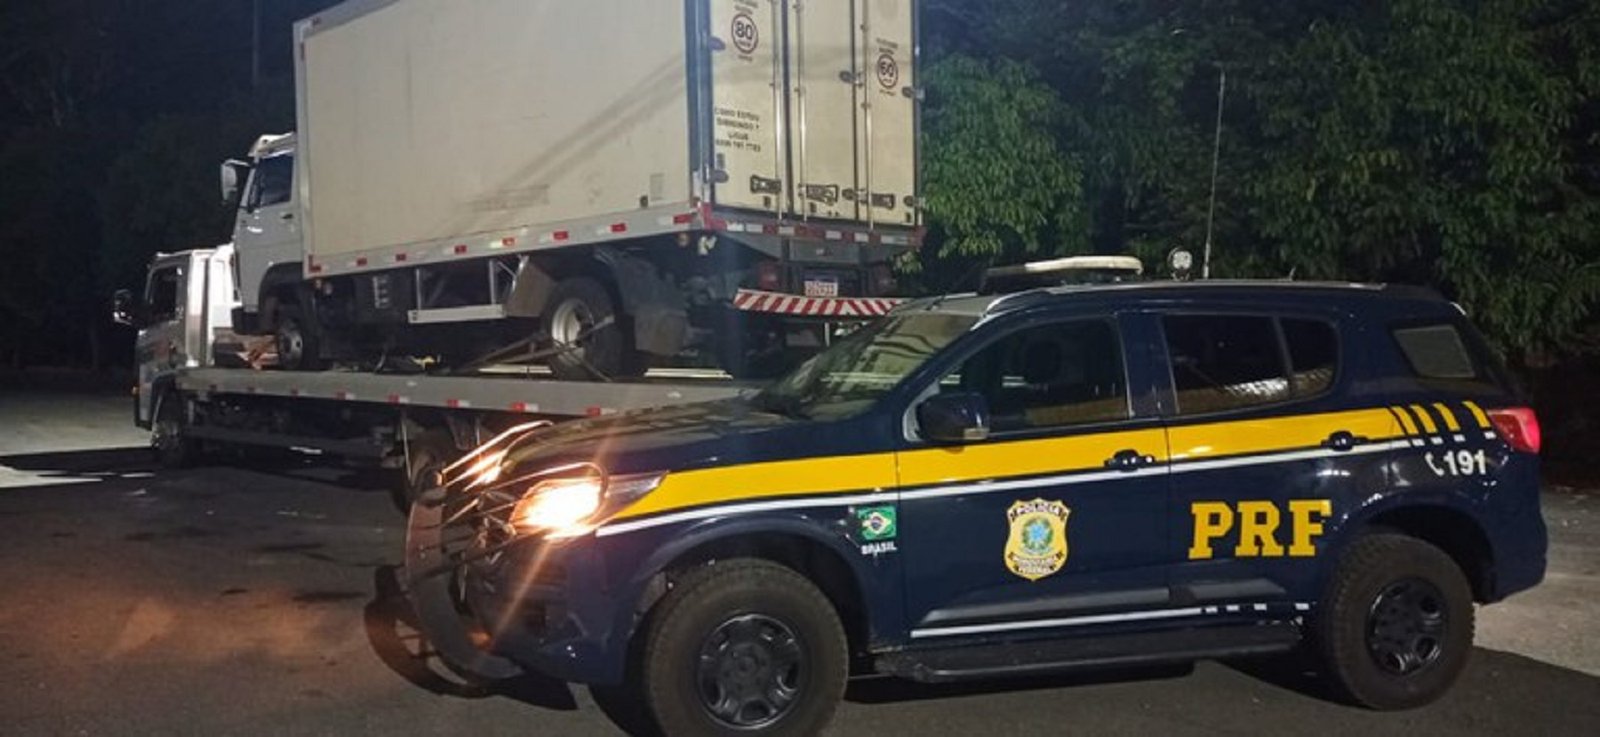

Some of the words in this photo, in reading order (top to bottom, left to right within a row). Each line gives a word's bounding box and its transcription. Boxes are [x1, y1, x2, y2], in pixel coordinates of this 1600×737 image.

[735, 21, 753, 40] 80
[880, 61, 894, 77] 60
[1443, 450, 1487, 475] 191
[1188, 499, 1332, 559] PRF
[861, 541, 897, 556] BRASIL
